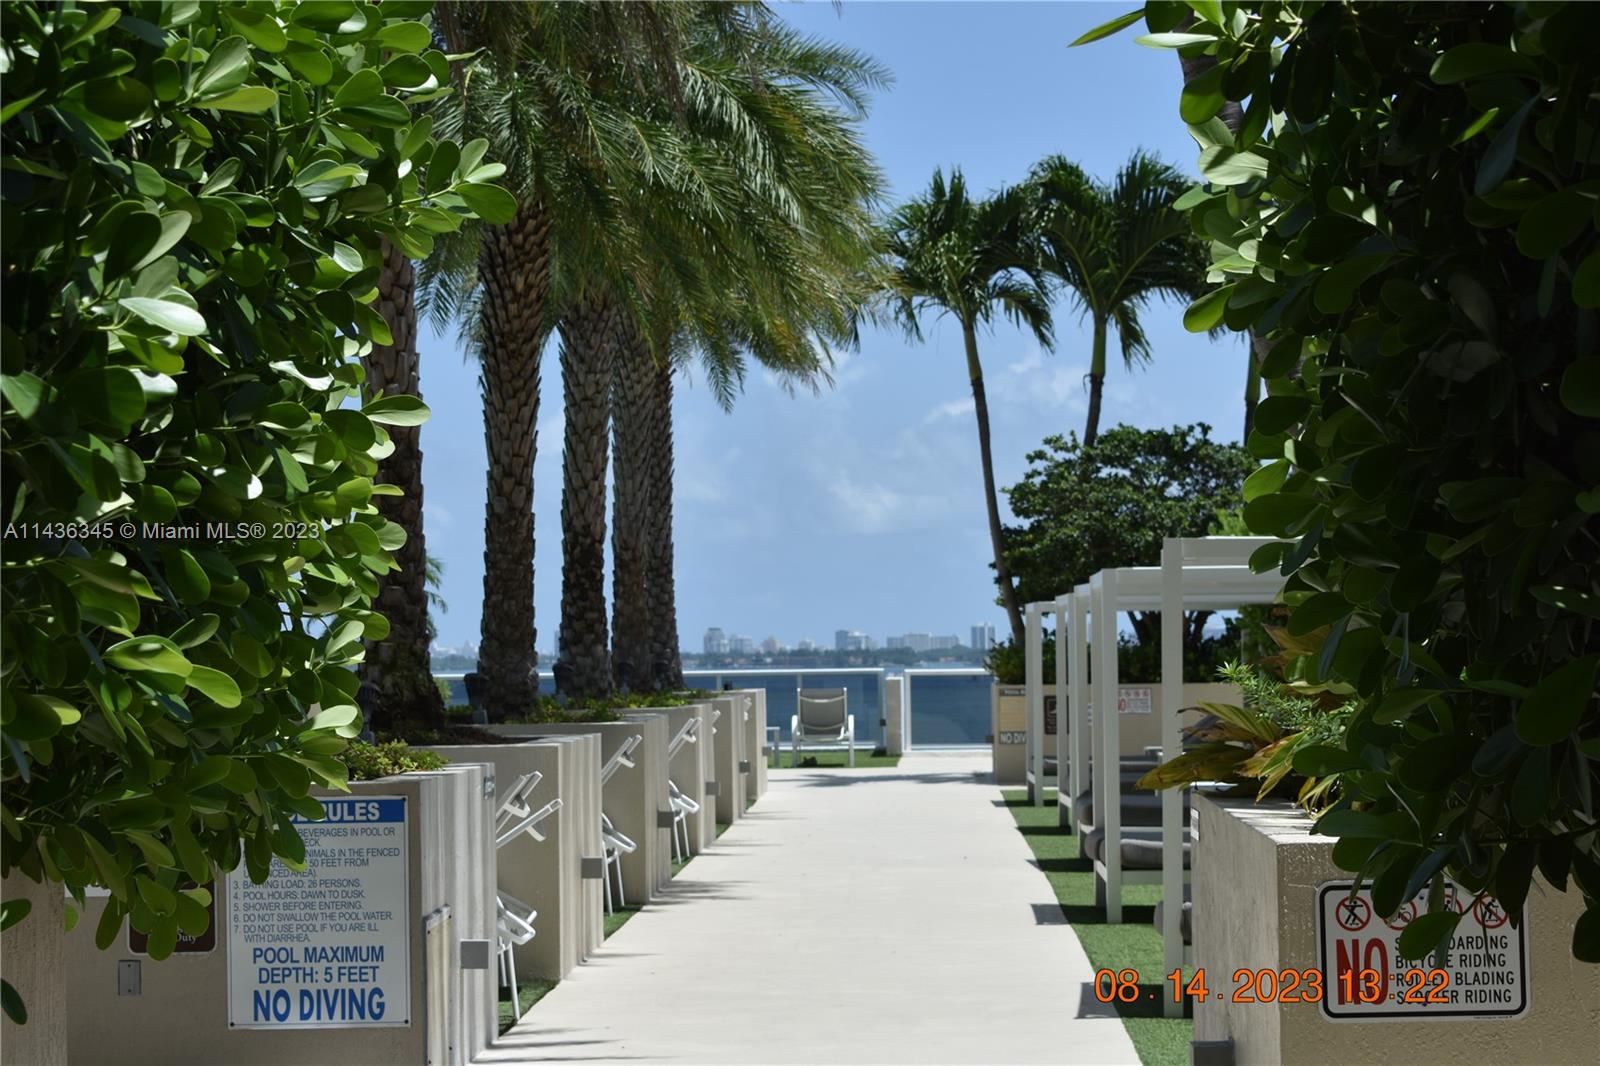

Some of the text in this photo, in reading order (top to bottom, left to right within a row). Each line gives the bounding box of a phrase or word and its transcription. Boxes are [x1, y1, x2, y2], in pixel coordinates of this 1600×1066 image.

[350, 827, 359, 836] IN
[361, 827, 382, 836] POOL
[383, 826, 395, 836] OR
[305, 847, 400, 858] NIMALS IN THE FENCED
[321, 858, 343, 867] FEET
[345, 857, 369, 867] FROM
[243, 880, 279, 889] BAING
[243, 891, 265, 900] POOL
[301, 890, 326, 899] DAWN
[328, 890, 339, 899] TO
[243, 902, 280, 911] SHOWER
[282, 901, 317, 911] BEFORE
[243, 913, 256, 922] DO
[258, 913, 275, 922] NOT
[276, 912, 318, 922] SWALLOW
[320, 912, 337, 921] THE
[338, 911, 361, 921] POOL
[243, 924, 256, 934] DO
[258, 924, 275, 933] NOT
[277, 924, 295, 933] USE
[296, 923, 318, 933] POOL
[320, 923, 327, 932] IF
[329, 923, 348, 932] YOU
[349, 922, 366, 932] ARE
[367, 922, 379, 931] ILL
[244, 934, 266, 943] WITH
[1395, 935, 1508, 951] SOARDNG
[252, 946, 385, 964] POOL MAXIMUM
[1395, 953, 1506, 969] BICYCE RIDING
[258, 966, 380, 984] DEPTH: 5 FEET
[1336, 938, 1389, 1005] NO
[1455, 971, 1514, 986] BLADING
[1465, 989, 1512, 1004] RIDING
[253, 987, 385, 1022] NO DIVING
